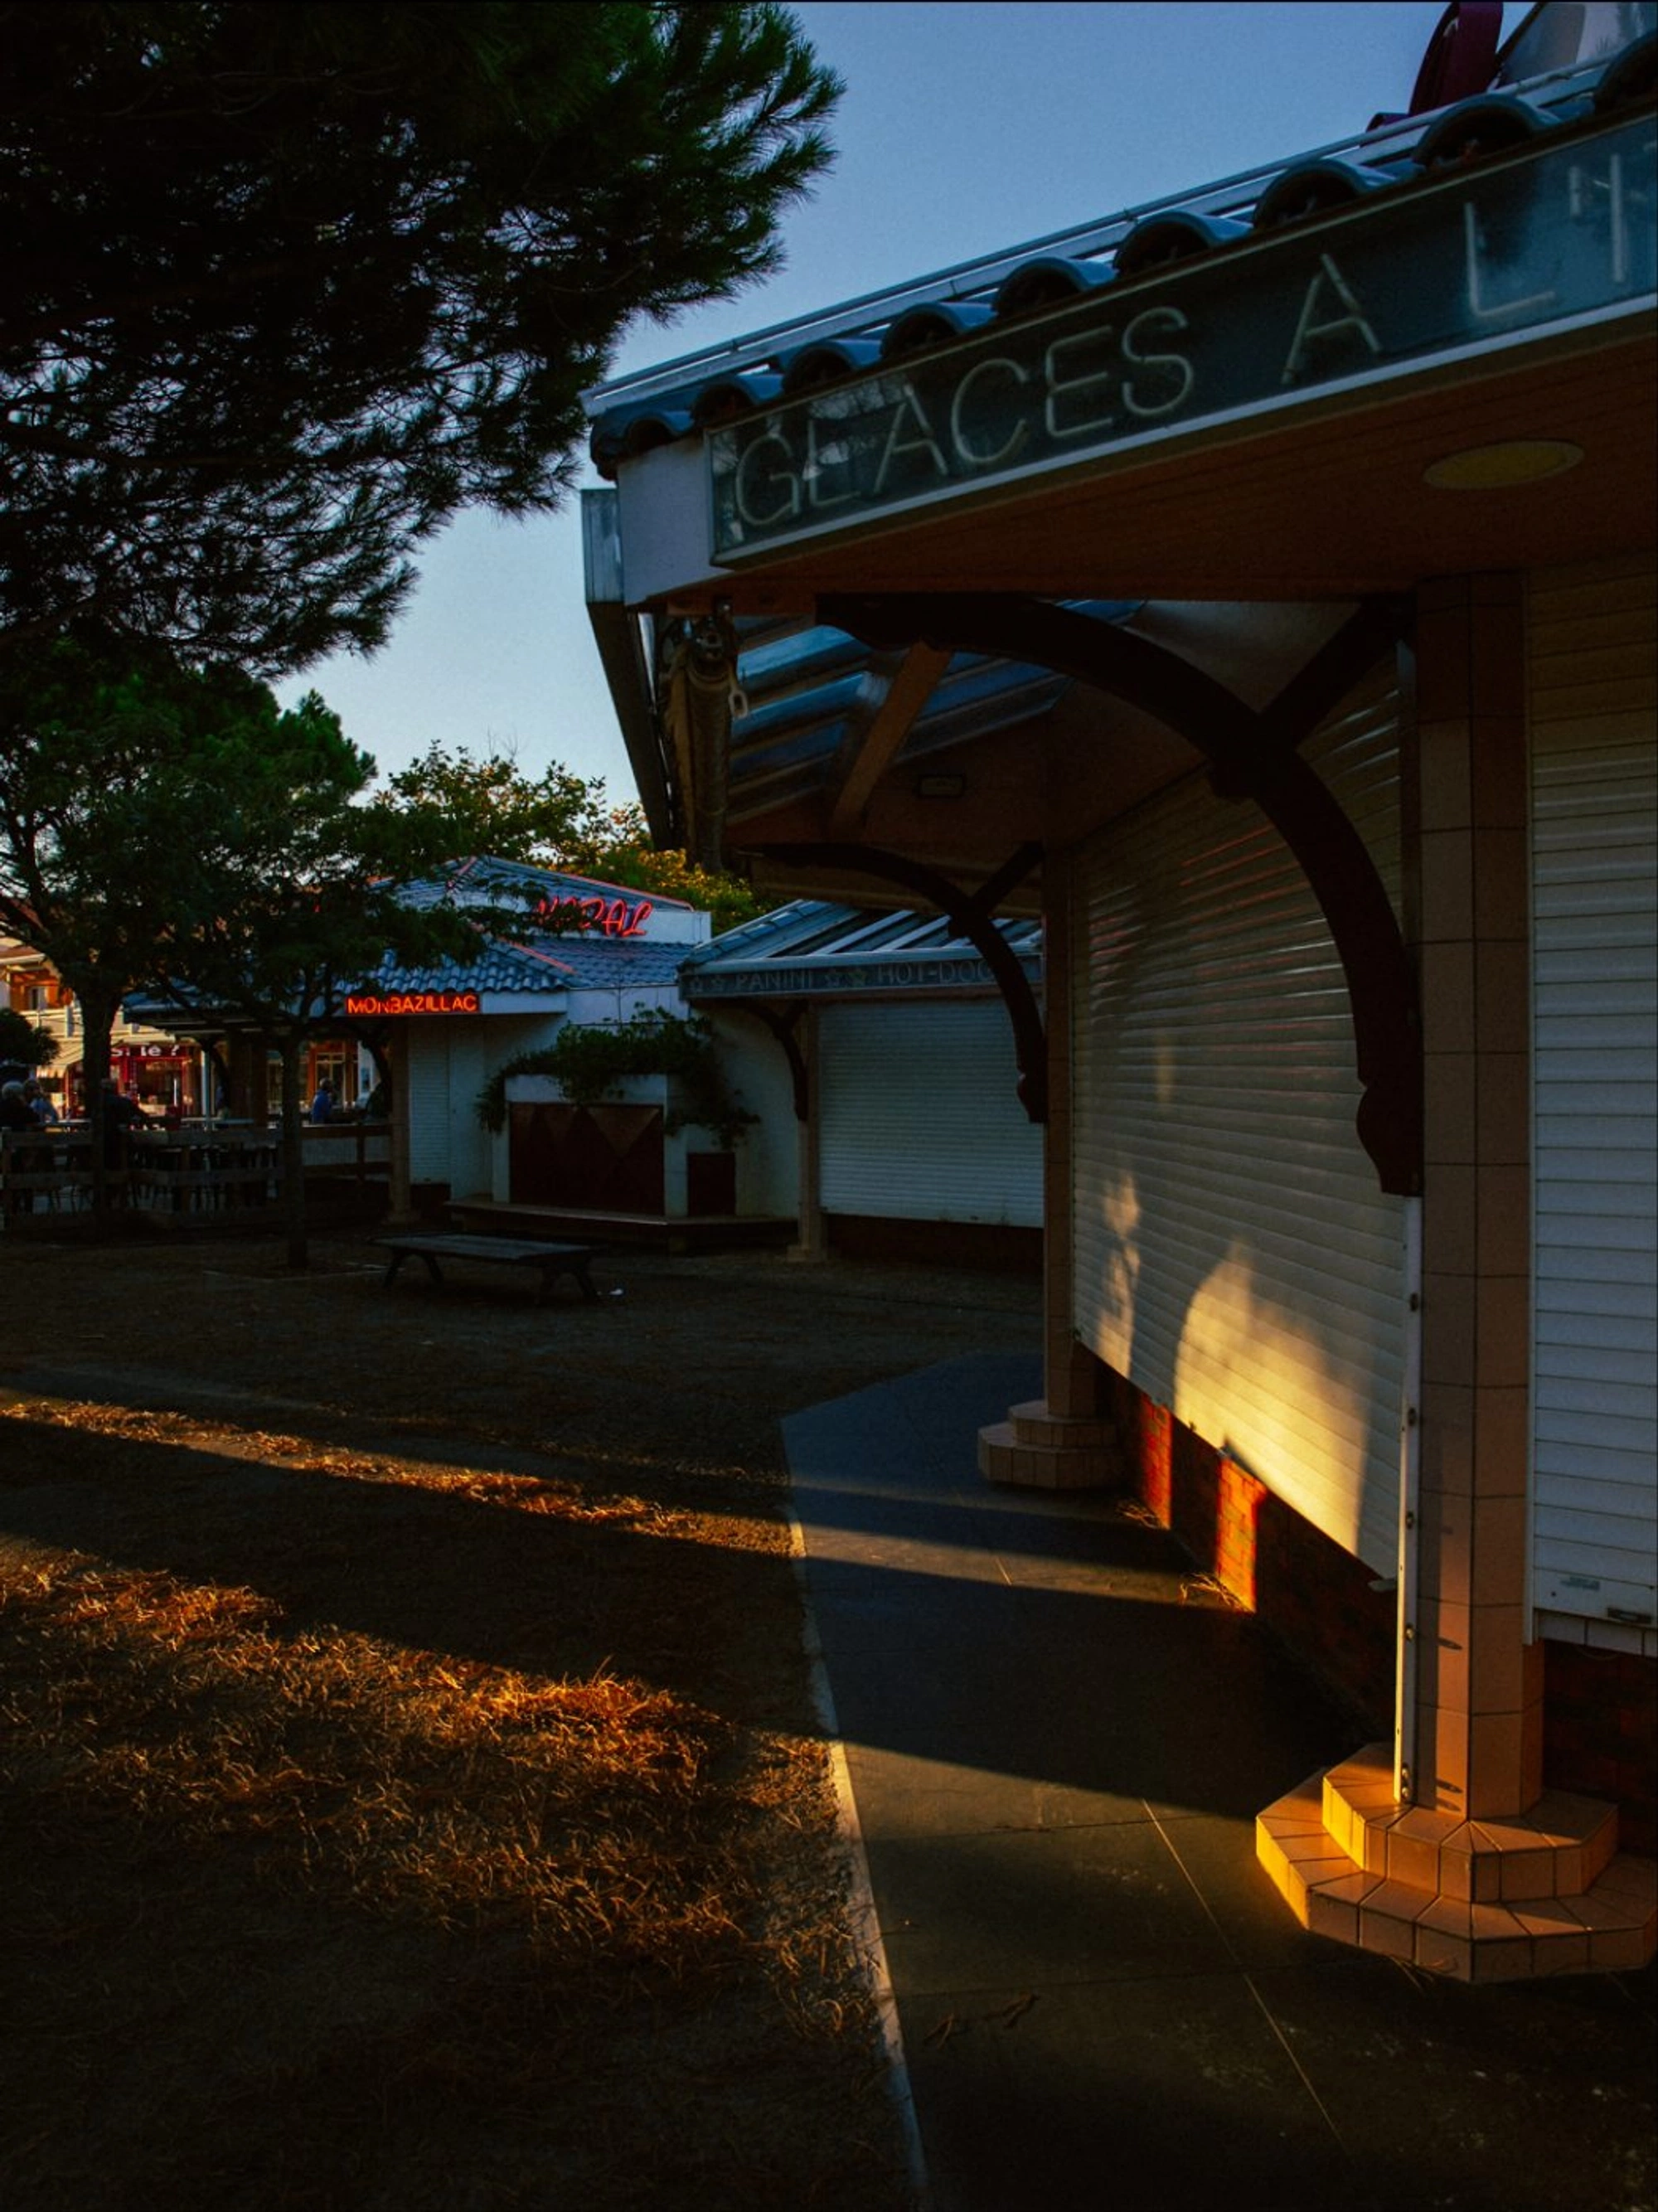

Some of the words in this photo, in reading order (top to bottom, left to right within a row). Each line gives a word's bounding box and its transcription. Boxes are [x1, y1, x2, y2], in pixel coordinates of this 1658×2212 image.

[734, 306, 1195, 526] GLACES
[1282, 253, 1384, 386] A
[735, 968, 812, 991] PANINI
[347, 996, 478, 1014] MONBAZILLAC
